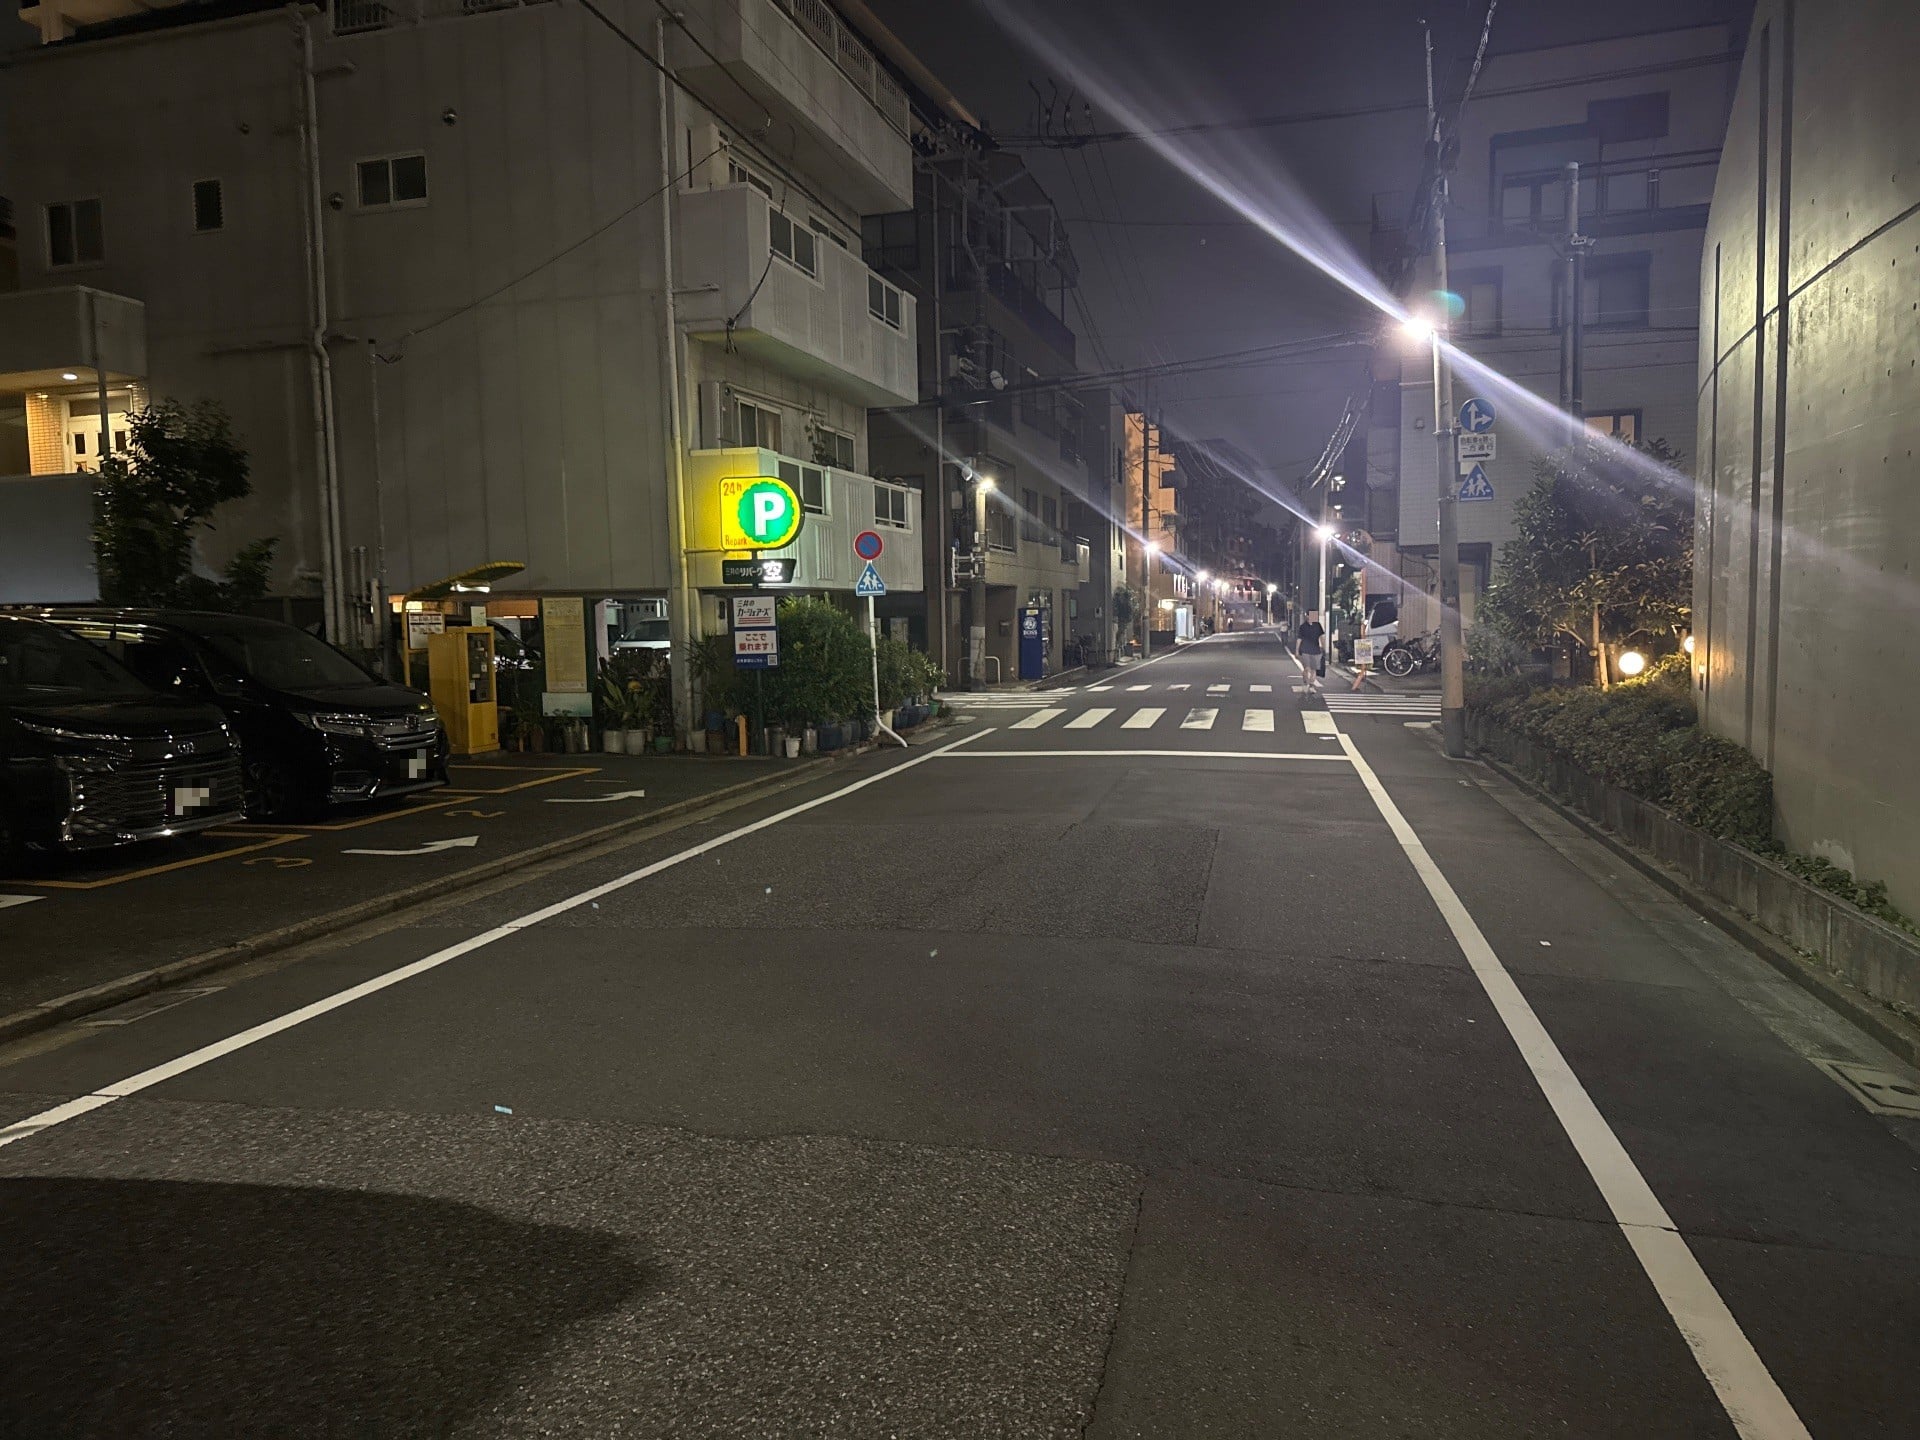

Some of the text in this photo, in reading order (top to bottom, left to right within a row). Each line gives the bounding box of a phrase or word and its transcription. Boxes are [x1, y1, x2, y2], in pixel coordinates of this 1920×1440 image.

[754, 492, 786, 536] P
[725, 534, 747, 547] Repark
[762, 560, 783, 582] 空
[737, 599, 755, 608] 三井の
[745, 633, 767, 642] ここで
